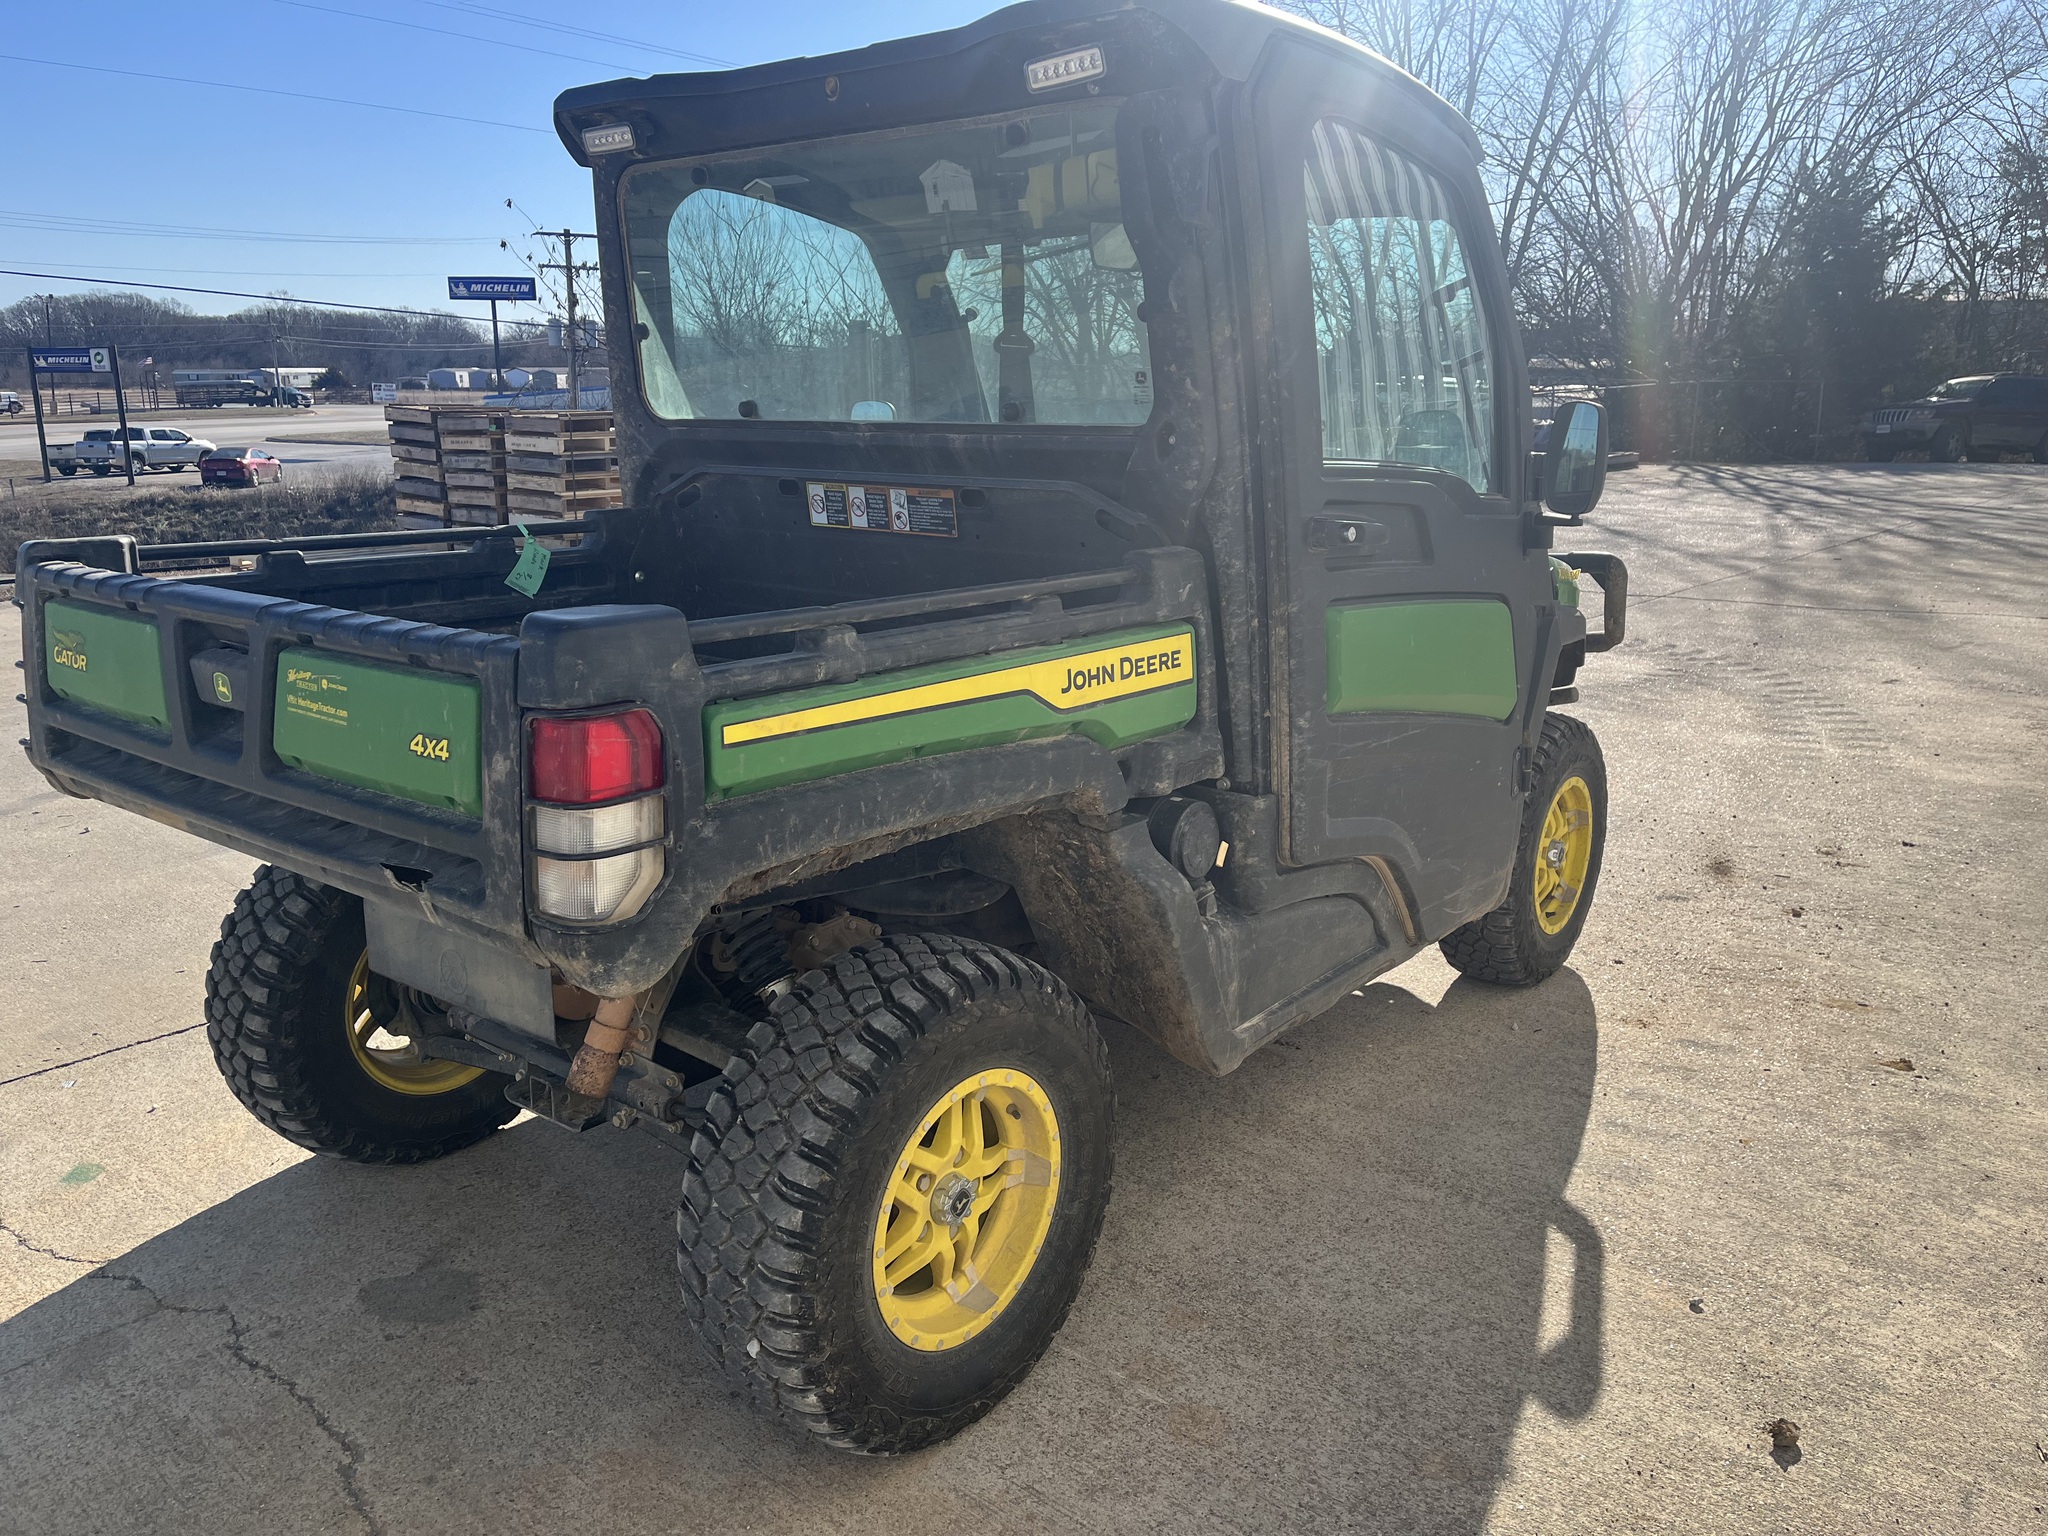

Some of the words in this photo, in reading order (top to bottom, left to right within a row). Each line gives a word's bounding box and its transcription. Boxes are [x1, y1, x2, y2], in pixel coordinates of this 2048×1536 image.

[470, 283, 530, 293] MICHELIN
[47, 356, 90, 364] MICHELIN
[53, 646, 87, 671] GATOR
[1061, 663, 1115, 694] JOHN
[1120, 650, 1181, 681] DEERE
